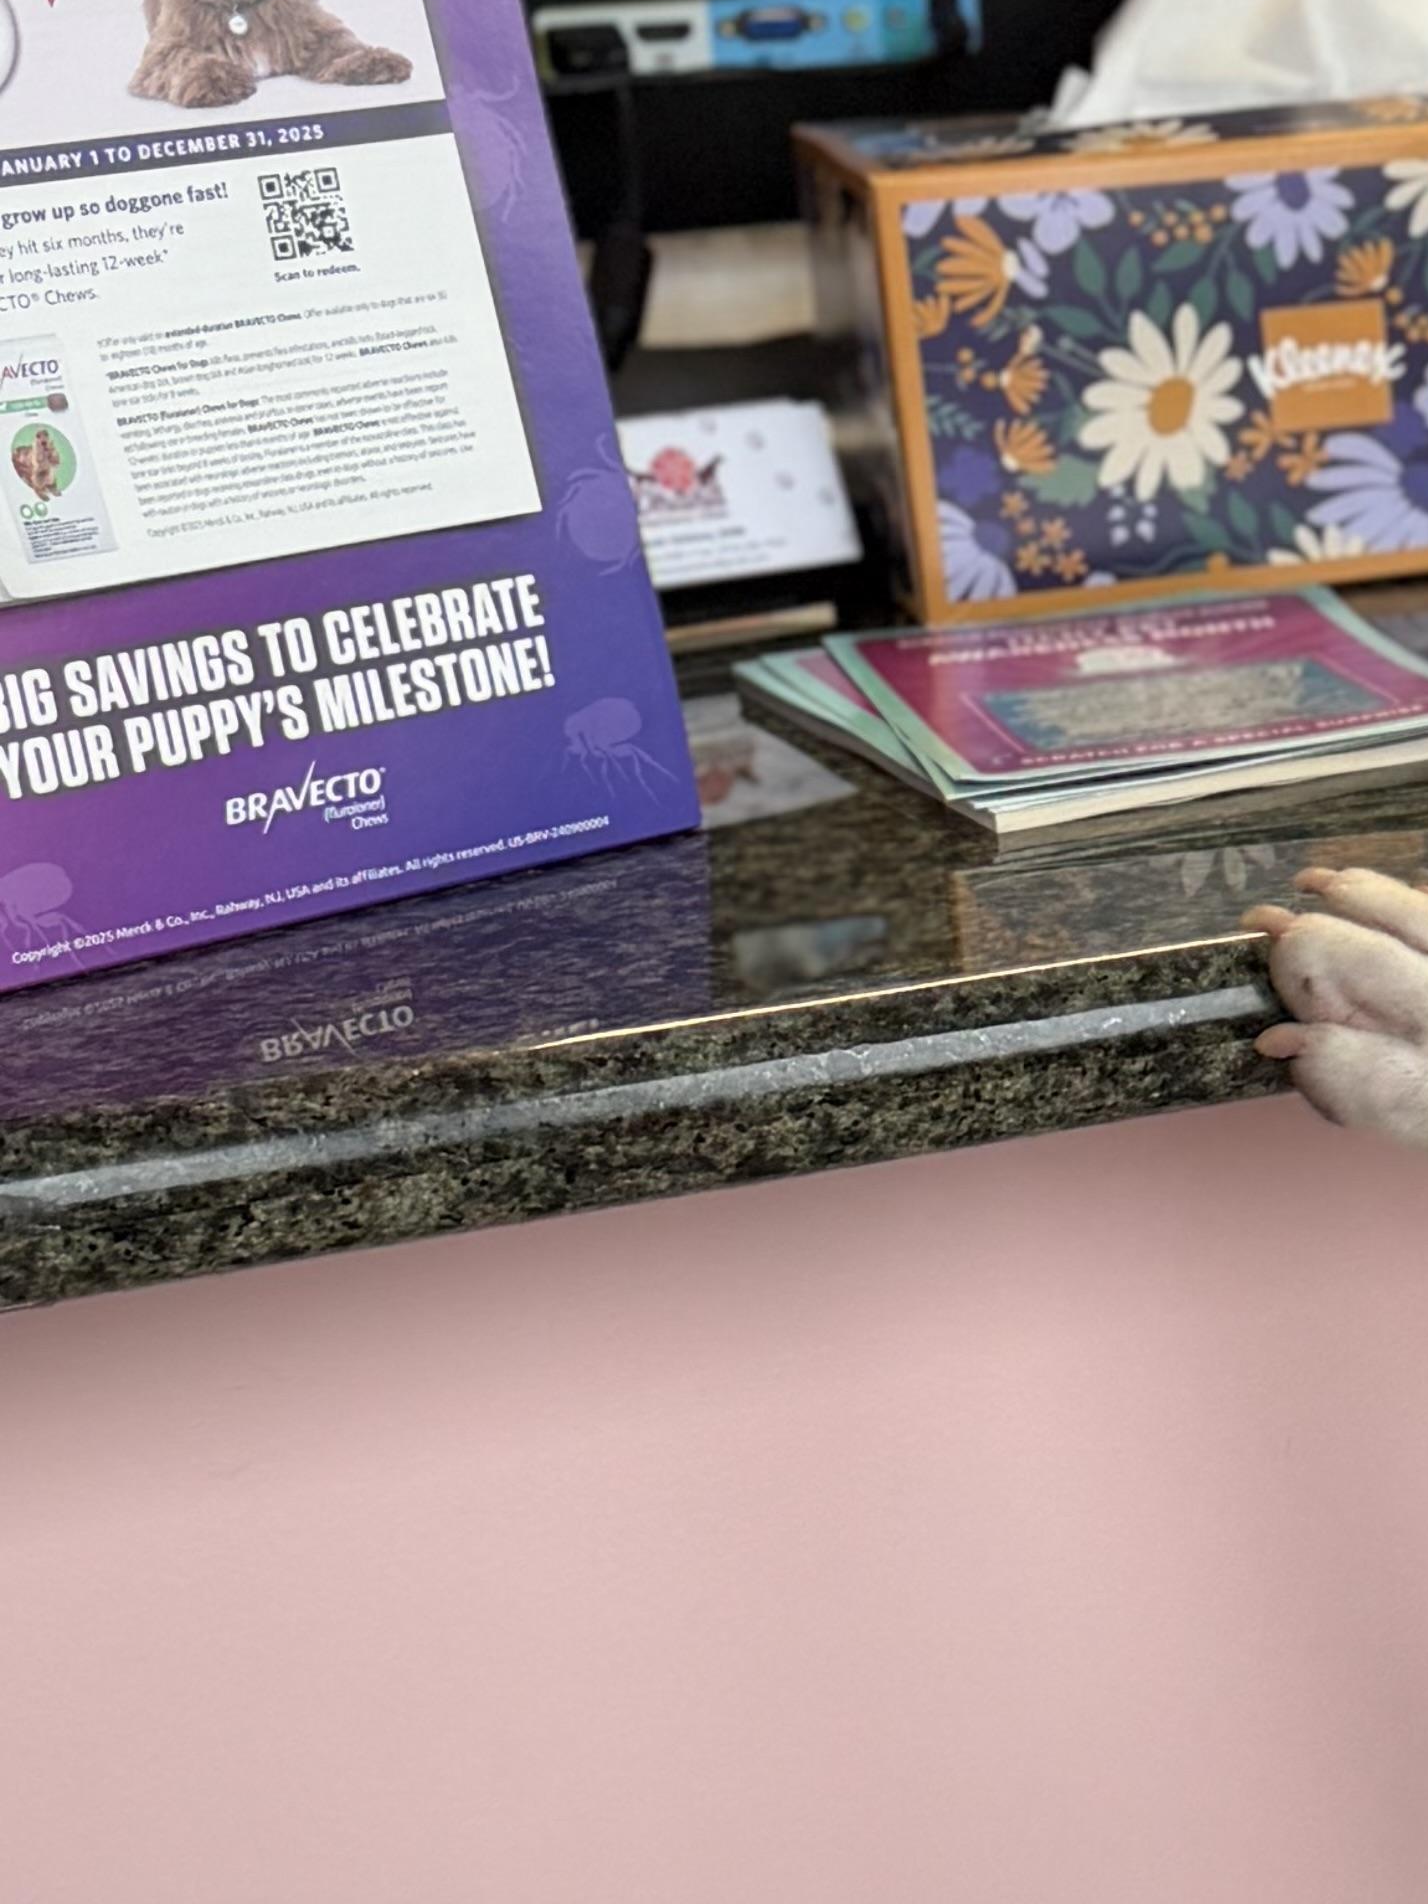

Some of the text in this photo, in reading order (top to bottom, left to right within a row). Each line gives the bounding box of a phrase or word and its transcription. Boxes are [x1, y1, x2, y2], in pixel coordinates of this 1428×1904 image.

[90, 150, 99, 166] 1
[106, 146, 131, 164] TO
[138, 133, 240, 160] DECEMBER
[247, 130, 272, 147] 31,
[278, 124, 324, 144] 2025
[1, 182, 228, 230] grow up so doggone fast!
[17, 241, 39, 255] hit
[43, 236, 62, 253] six
[68, 228, 128, 247] months,
[132, 221, 184, 241] they're
[9, 260, 100, 284] long-lasting
[274, 264, 361, 283] Scan to redeem.
[1247, 334, 1407, 400] Kleenex
[63, 629, 255, 718] SAVINGS
[257, 617, 318, 678] TO
[322, 574, 545, 667] CELEBRATE
[0, 723, 121, 800] YOUR
[313, 635, 556, 734] MILESTONE!
[351, 813, 389, 830] Chews
[11, 940, 72, 965] Copyright
[116, 920, 152, 940] Merck
[285, 884, 311, 900] USA
[312, 877, 334, 894] and
[335, 876, 350, 889] its
[405, 857, 422, 871] All
[422, 853, 455, 869] rights
